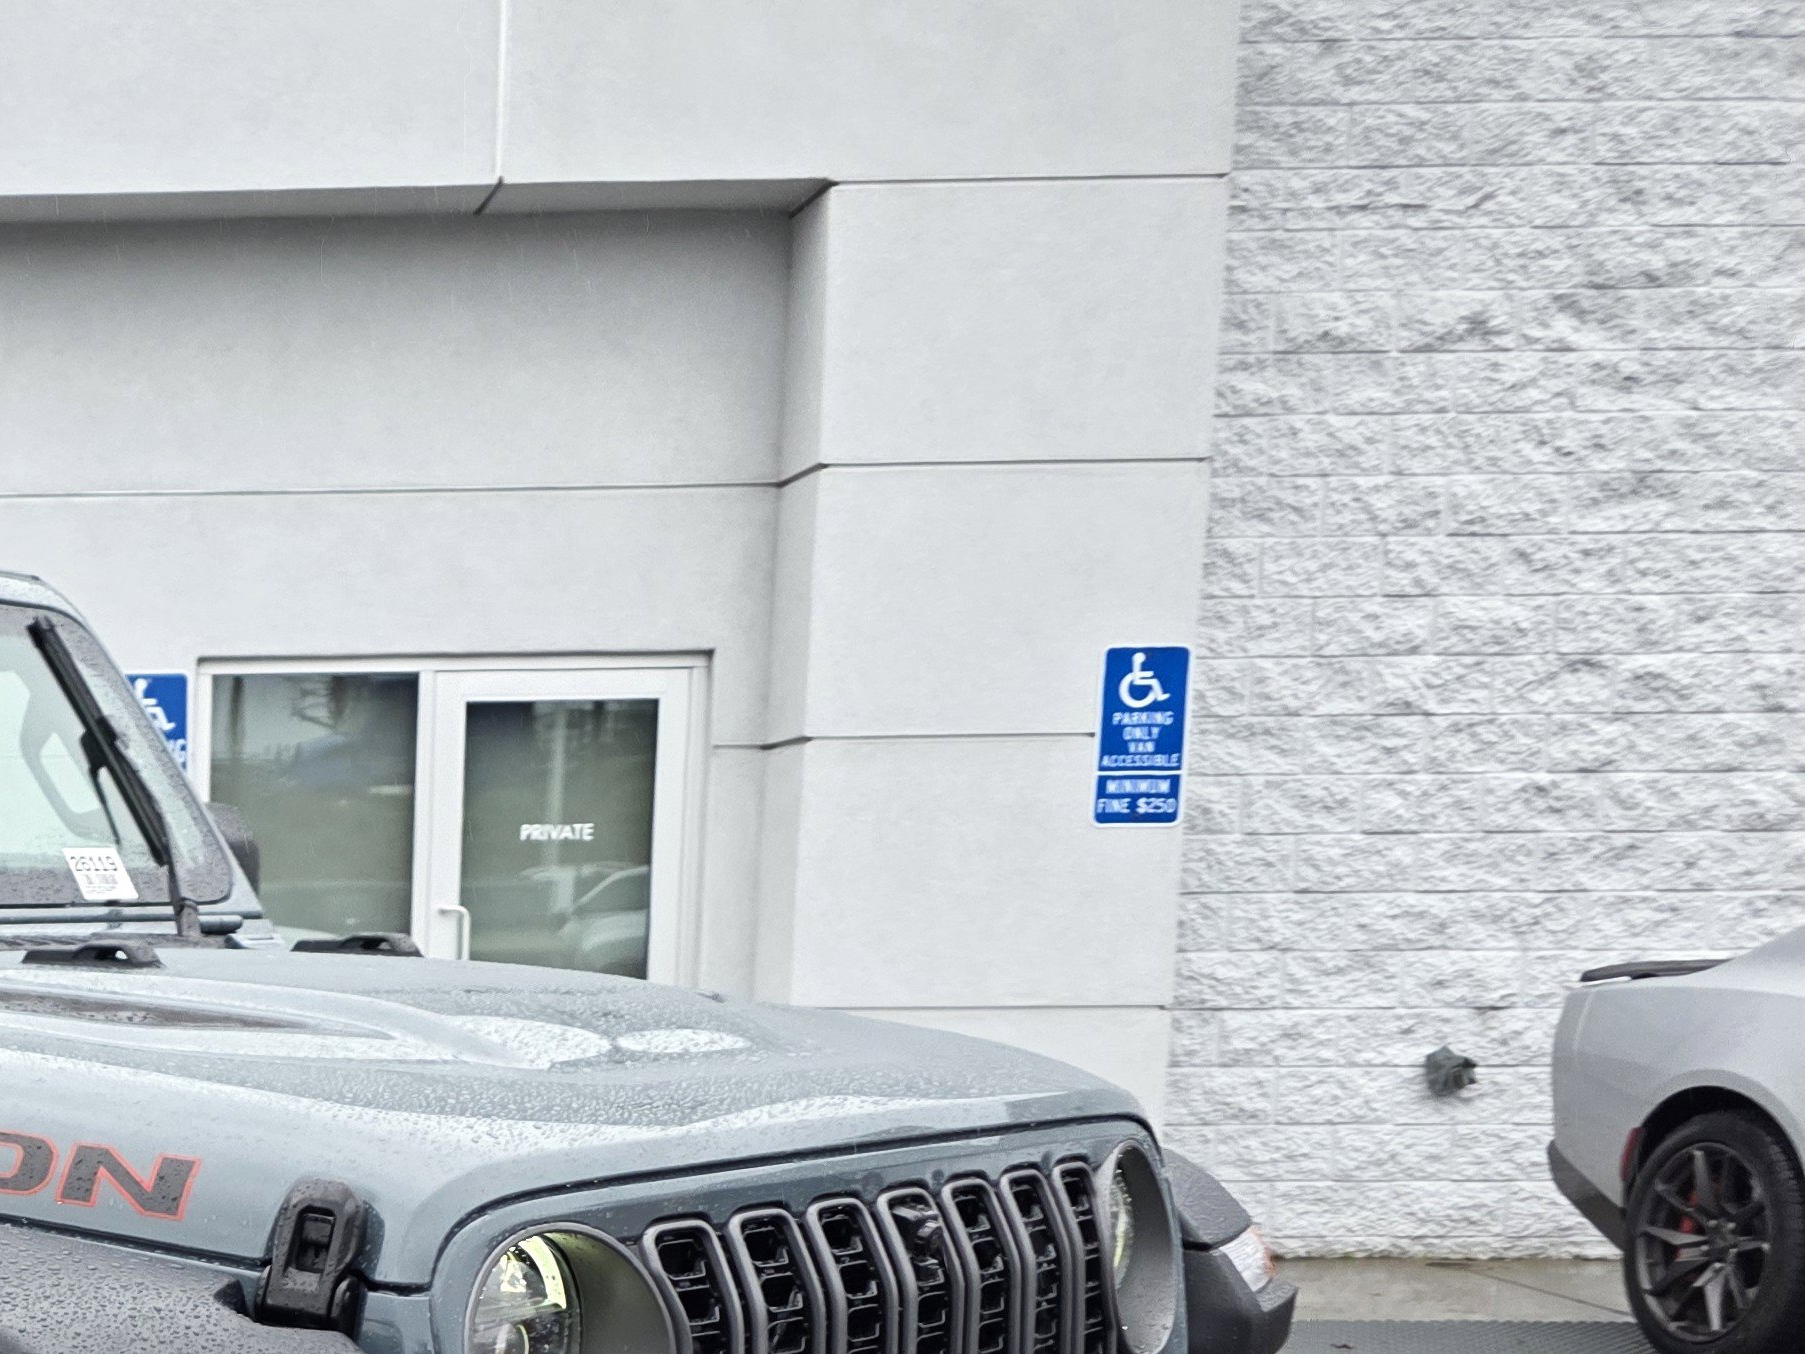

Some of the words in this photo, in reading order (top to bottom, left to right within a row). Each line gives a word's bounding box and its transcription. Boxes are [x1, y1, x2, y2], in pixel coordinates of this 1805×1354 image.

[1112, 711, 1175, 726] PARKING
[1122, 726, 1162, 740] ONLY
[1127, 741, 1157, 754] VAN
[1100, 753, 1181, 768] ACCESSIBLE
[1105, 779, 1171, 794] MINIMUM
[1097, 798, 1132, 813] FINE
[1135, 797, 1177, 814] $250
[519, 823, 595, 841] PRIVATE
